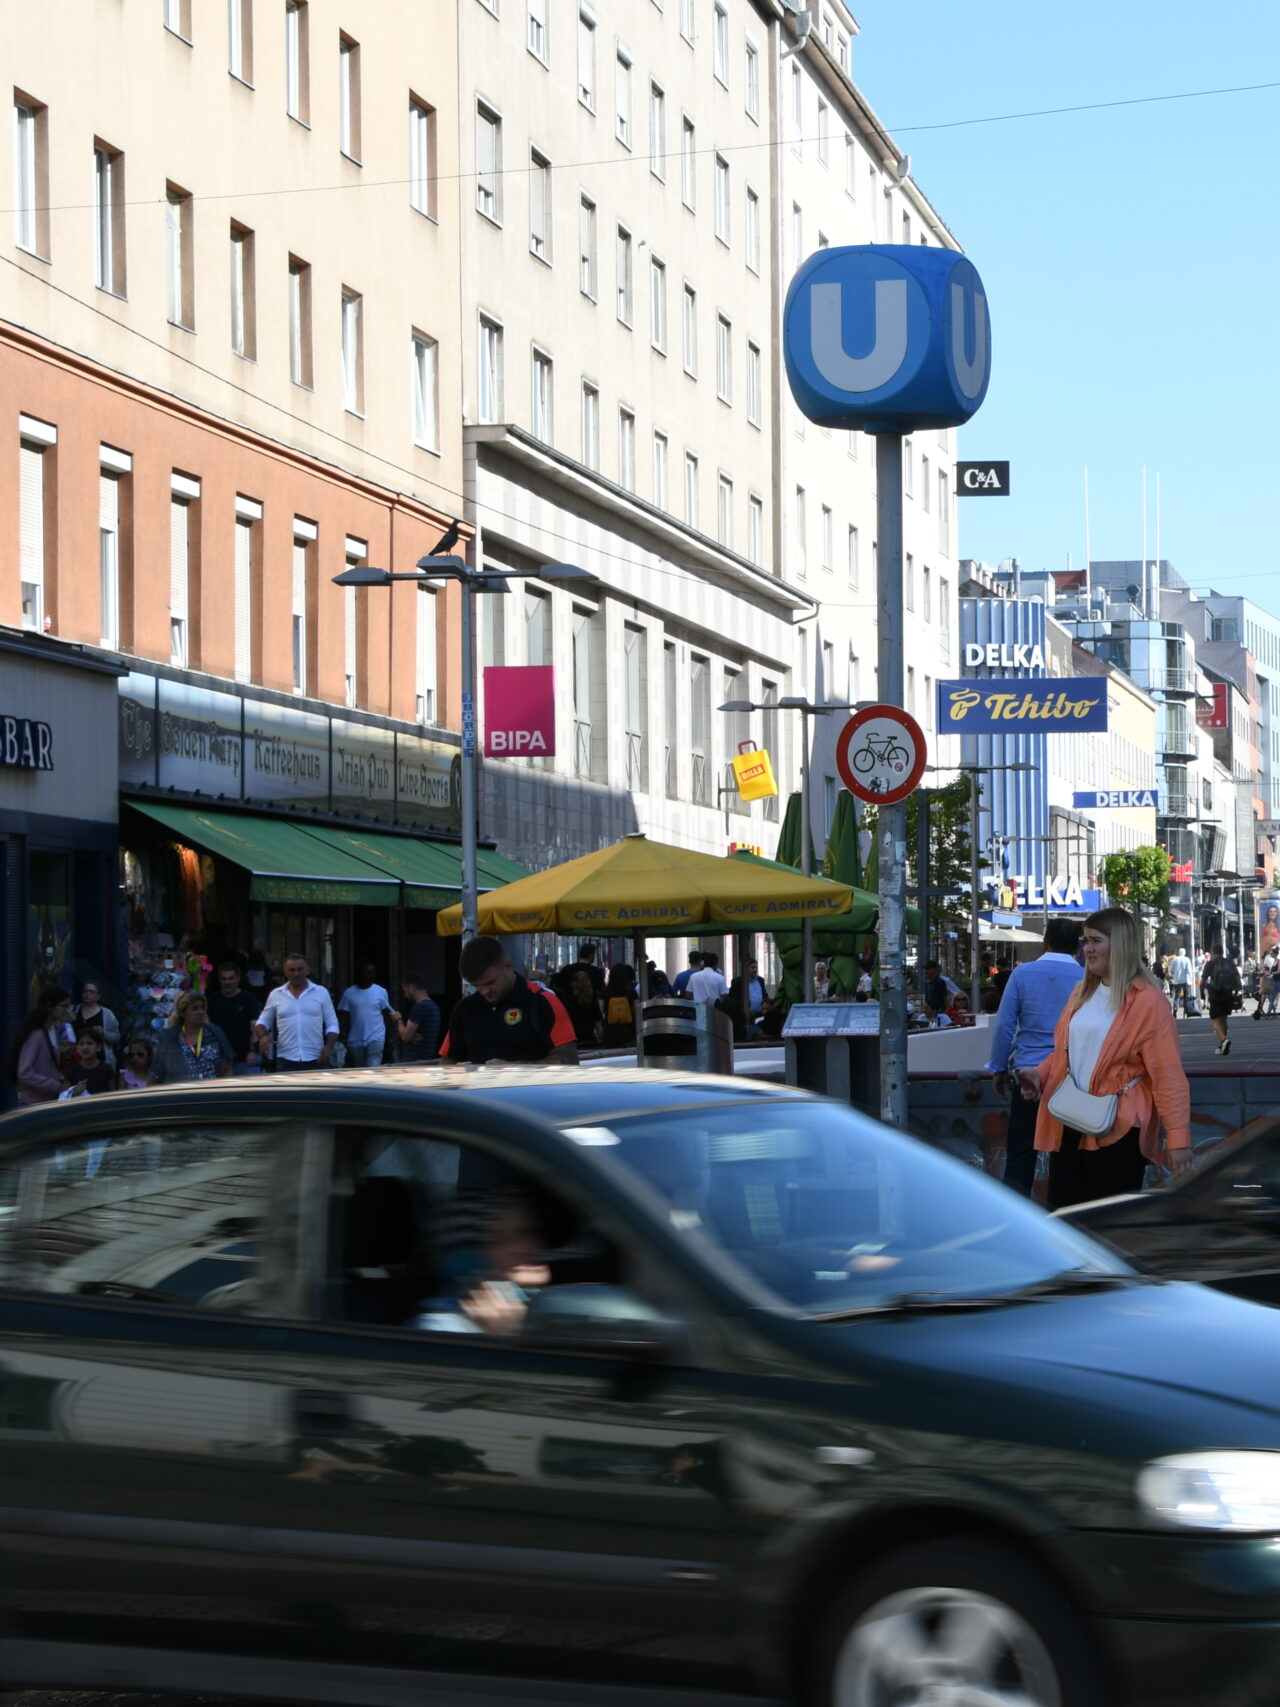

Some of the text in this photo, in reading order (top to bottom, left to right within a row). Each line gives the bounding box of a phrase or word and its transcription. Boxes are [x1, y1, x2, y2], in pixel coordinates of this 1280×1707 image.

[810, 279, 908, 393] U
[951, 282, 986, 399] U
[963, 468, 1002, 489] C&A
[965, 643, 1045, 669] DELKA
[984, 692, 1100, 720] Tchibo
[0, 716, 52, 769] BAR
[490, 729, 548, 751] BIPA
[253, 728, 321, 782] Kaffeehaus
[337, 748, 365, 793] Irish
[367, 752, 390, 800] Pub
[399, 759, 419, 796] Live
[419, 763, 449, 807] Sports
[1096, 791, 1155, 808] DELKA
[574, 905, 693, 921] CAFE ADMIRAL
[723, 897, 841, 914] CAFE ADMIRAL
